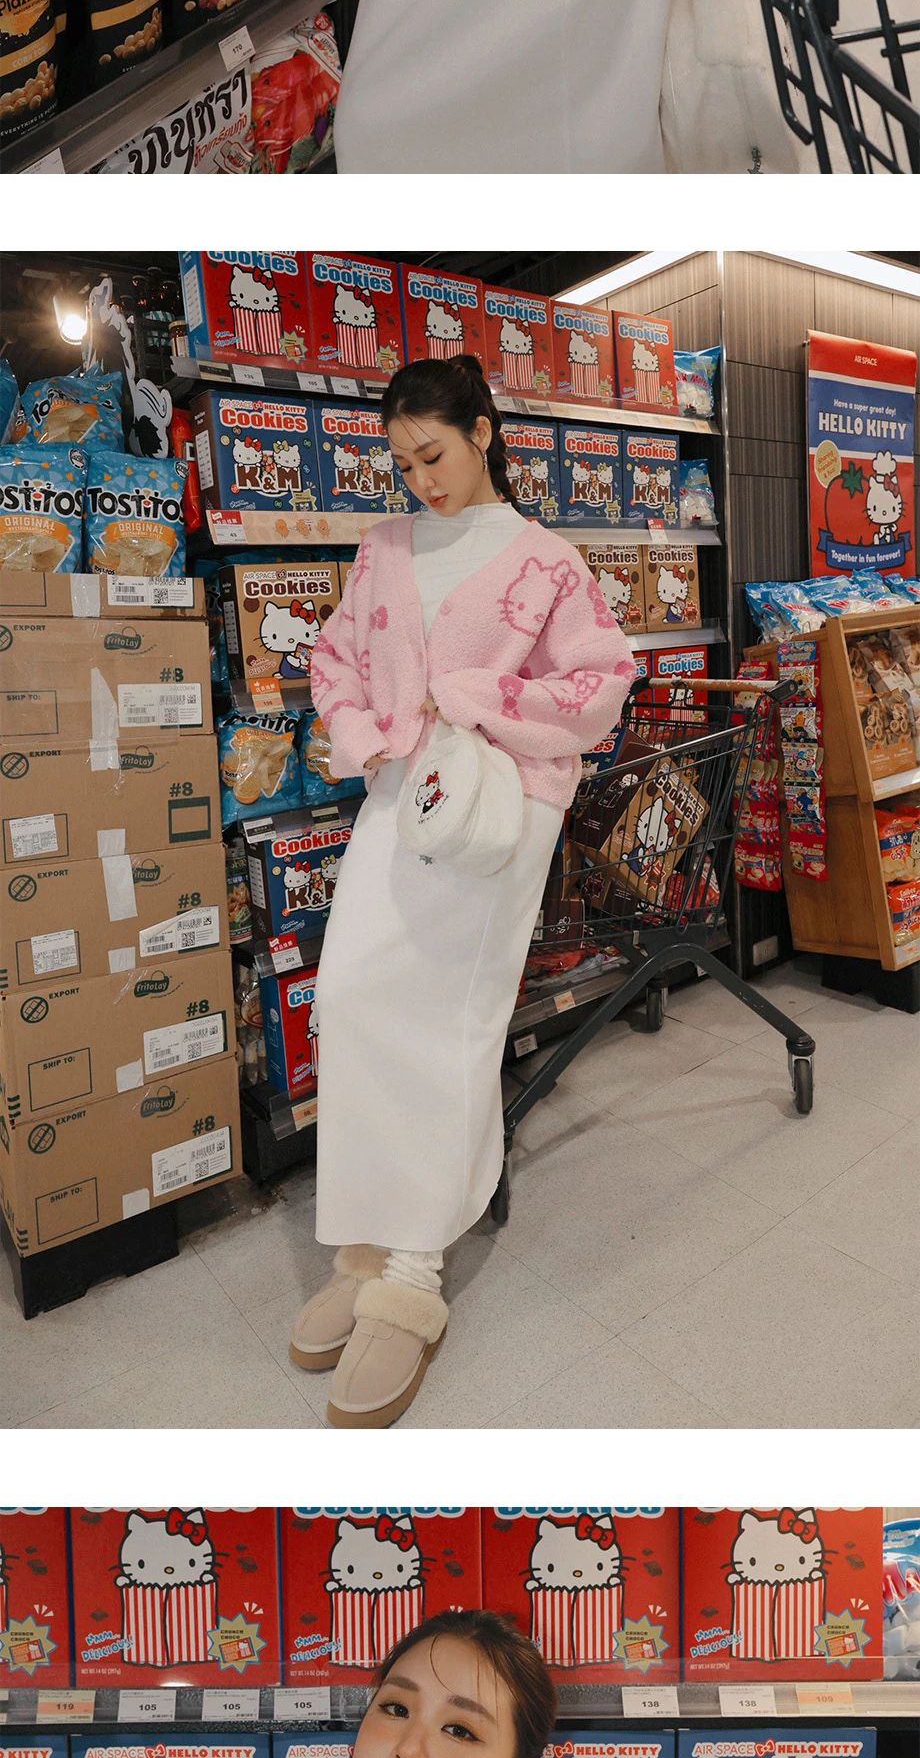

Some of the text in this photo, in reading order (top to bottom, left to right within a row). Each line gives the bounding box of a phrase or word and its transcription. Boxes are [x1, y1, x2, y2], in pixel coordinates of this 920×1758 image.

[314, 264, 392, 292] Cookies
[409, 281, 476, 307] Cookies
[221, 409, 307, 431] Cookies
[818, 412, 907, 440] HELLO KITTY
[4, 517, 55, 531] ORIGINAL
[118, 523, 164, 534] ORIGINAL
[831, 549, 901, 563] Together forever!
[245, 580, 331, 596] Cookies
[160, 668, 183, 682] #8
[169, 782, 193, 797] #8
[716, 1744, 859, 1754] SPACE HELLO KITTY
